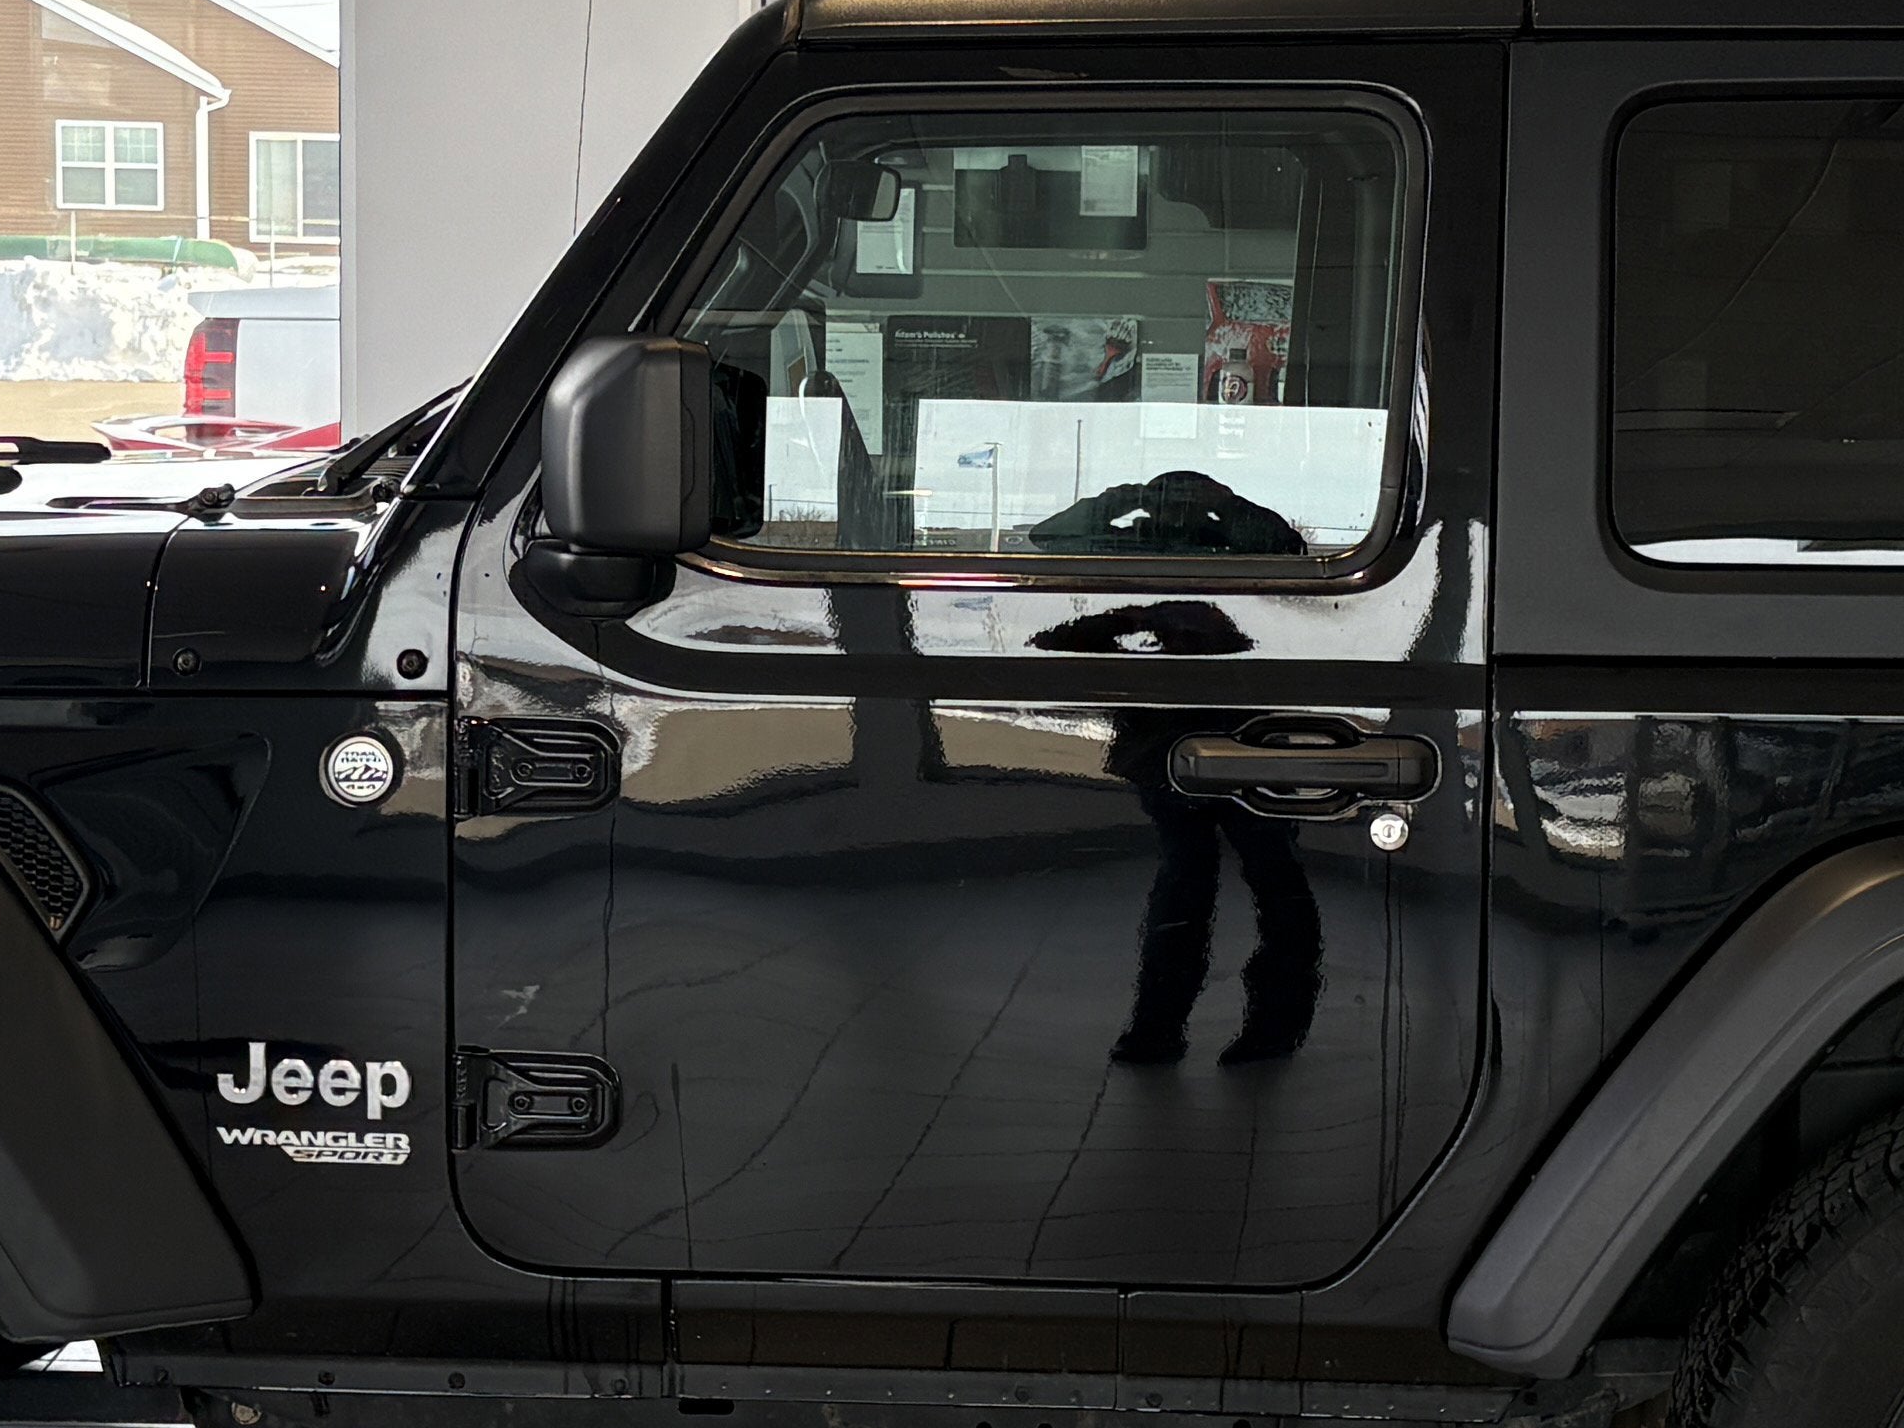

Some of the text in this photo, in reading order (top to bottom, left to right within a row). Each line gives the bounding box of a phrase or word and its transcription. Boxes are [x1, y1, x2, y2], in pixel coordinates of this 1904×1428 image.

[216, 1041, 412, 1120] Jeep
[216, 1126, 411, 1149] WRANGLER
[291, 1148, 408, 1162] SPORT
